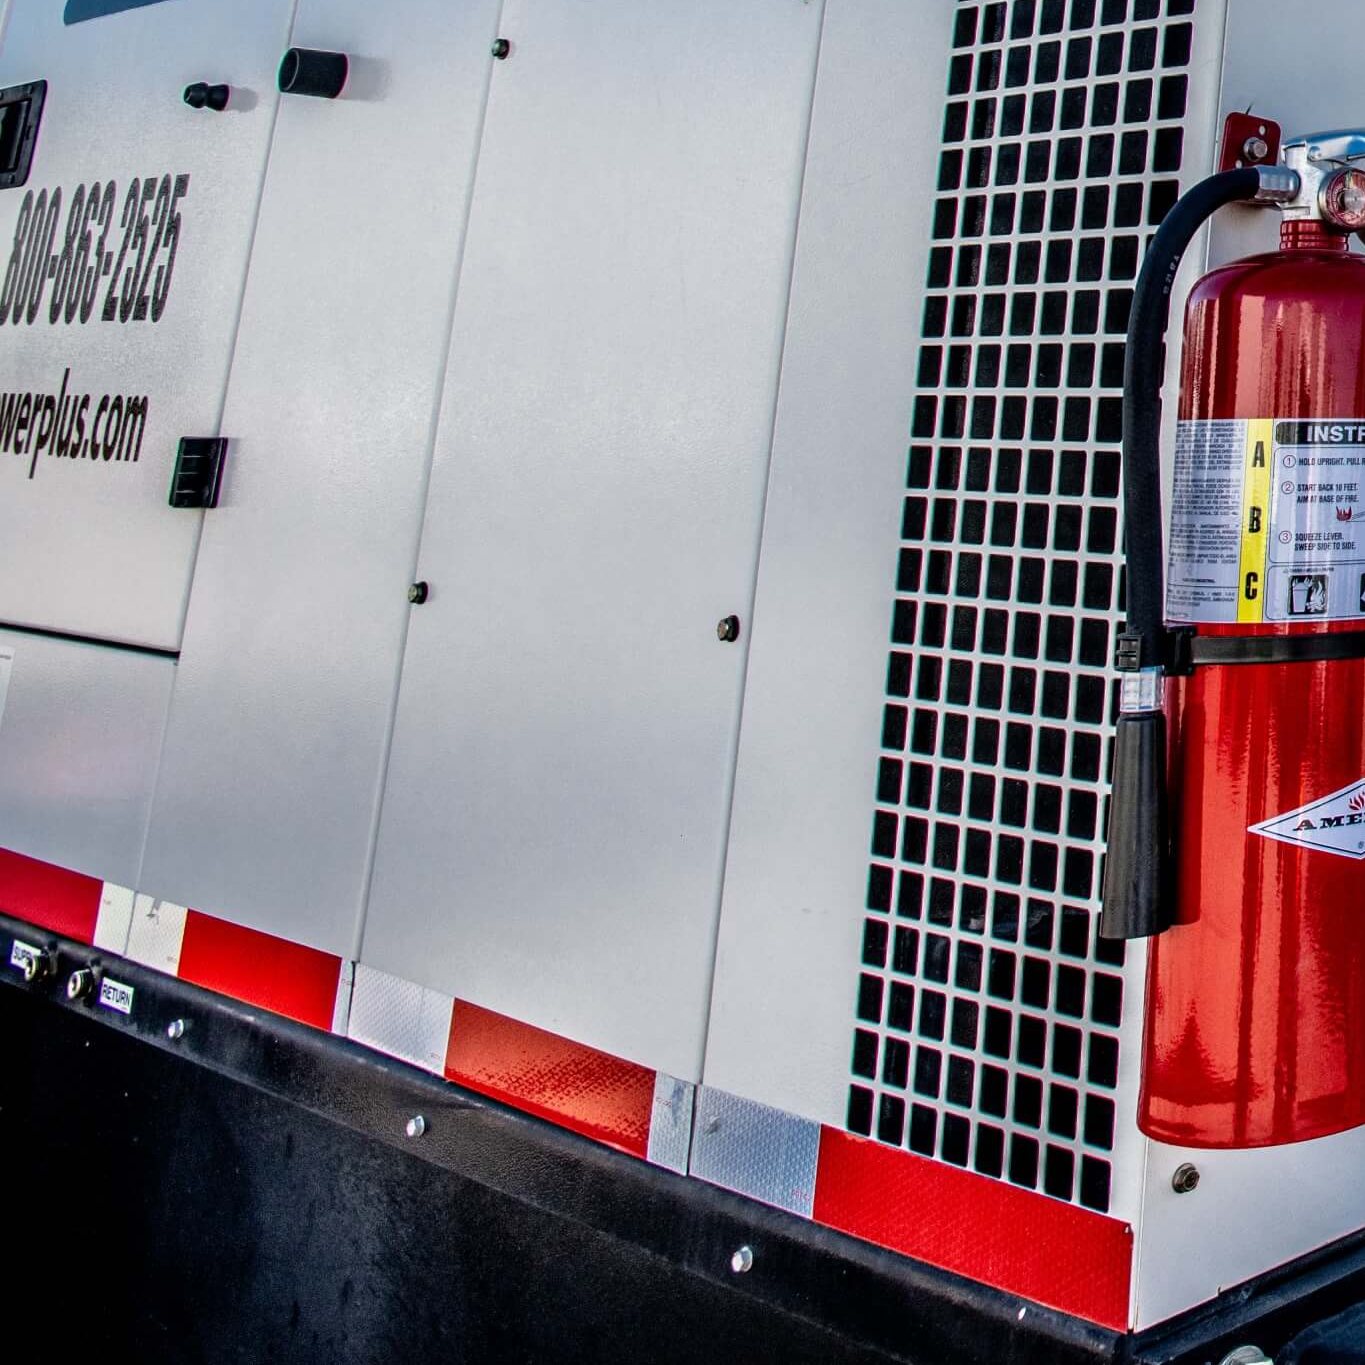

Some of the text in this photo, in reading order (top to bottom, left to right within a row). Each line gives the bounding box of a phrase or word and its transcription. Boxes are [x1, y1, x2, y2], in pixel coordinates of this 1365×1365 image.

[0, 173, 190, 325] 800-863-2525
[1251, 440, 1265, 468] A
[1298, 458, 1315, 466] HOLD
[1346, 457, 1361, 466] PULL
[1297, 484, 1316, 492] START
[1318, 483, 1333, 492] BACK
[1336, 483, 1343, 491] 10
[1297, 496, 1308, 504] AIM
[1319, 494, 1334, 503] BASE
[1336, 494, 1344, 502] OF
[1248, 507, 1262, 533] B
[1295, 532, 1322, 541] SQUEEZE
[1294, 542, 1314, 551] SWEEP
[1316, 542, 1331, 551] SIDE
[1332, 542, 1341, 550] TO
[1245, 571, 1258, 600] C
[102, 983, 131, 1005] RETURN
